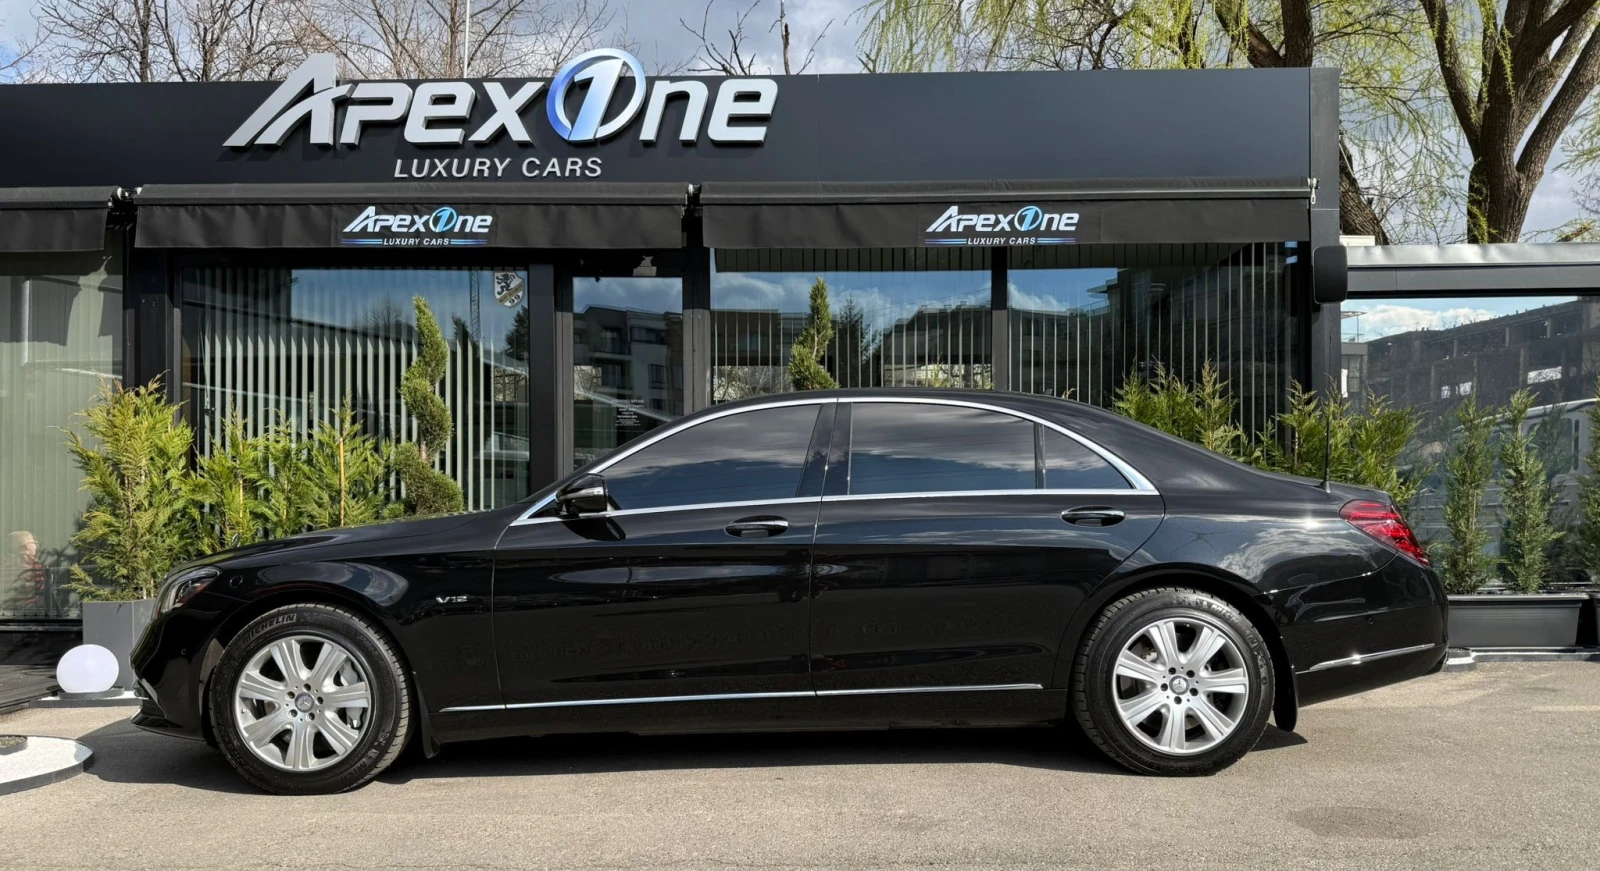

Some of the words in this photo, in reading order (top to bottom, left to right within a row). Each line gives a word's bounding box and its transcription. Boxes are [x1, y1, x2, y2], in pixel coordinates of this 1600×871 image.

[394, 158, 511, 179] LUXURY
[521, 156, 603, 178] CARS
[383, 238, 420, 246] LUXURY
[423, 237, 450, 246] CARS
[967, 237, 1006, 245] LUXURY
[1009, 237, 1037, 245] CARS
[435, 595, 468, 604] V12
[243, 613, 297, 644] MICHELIN
